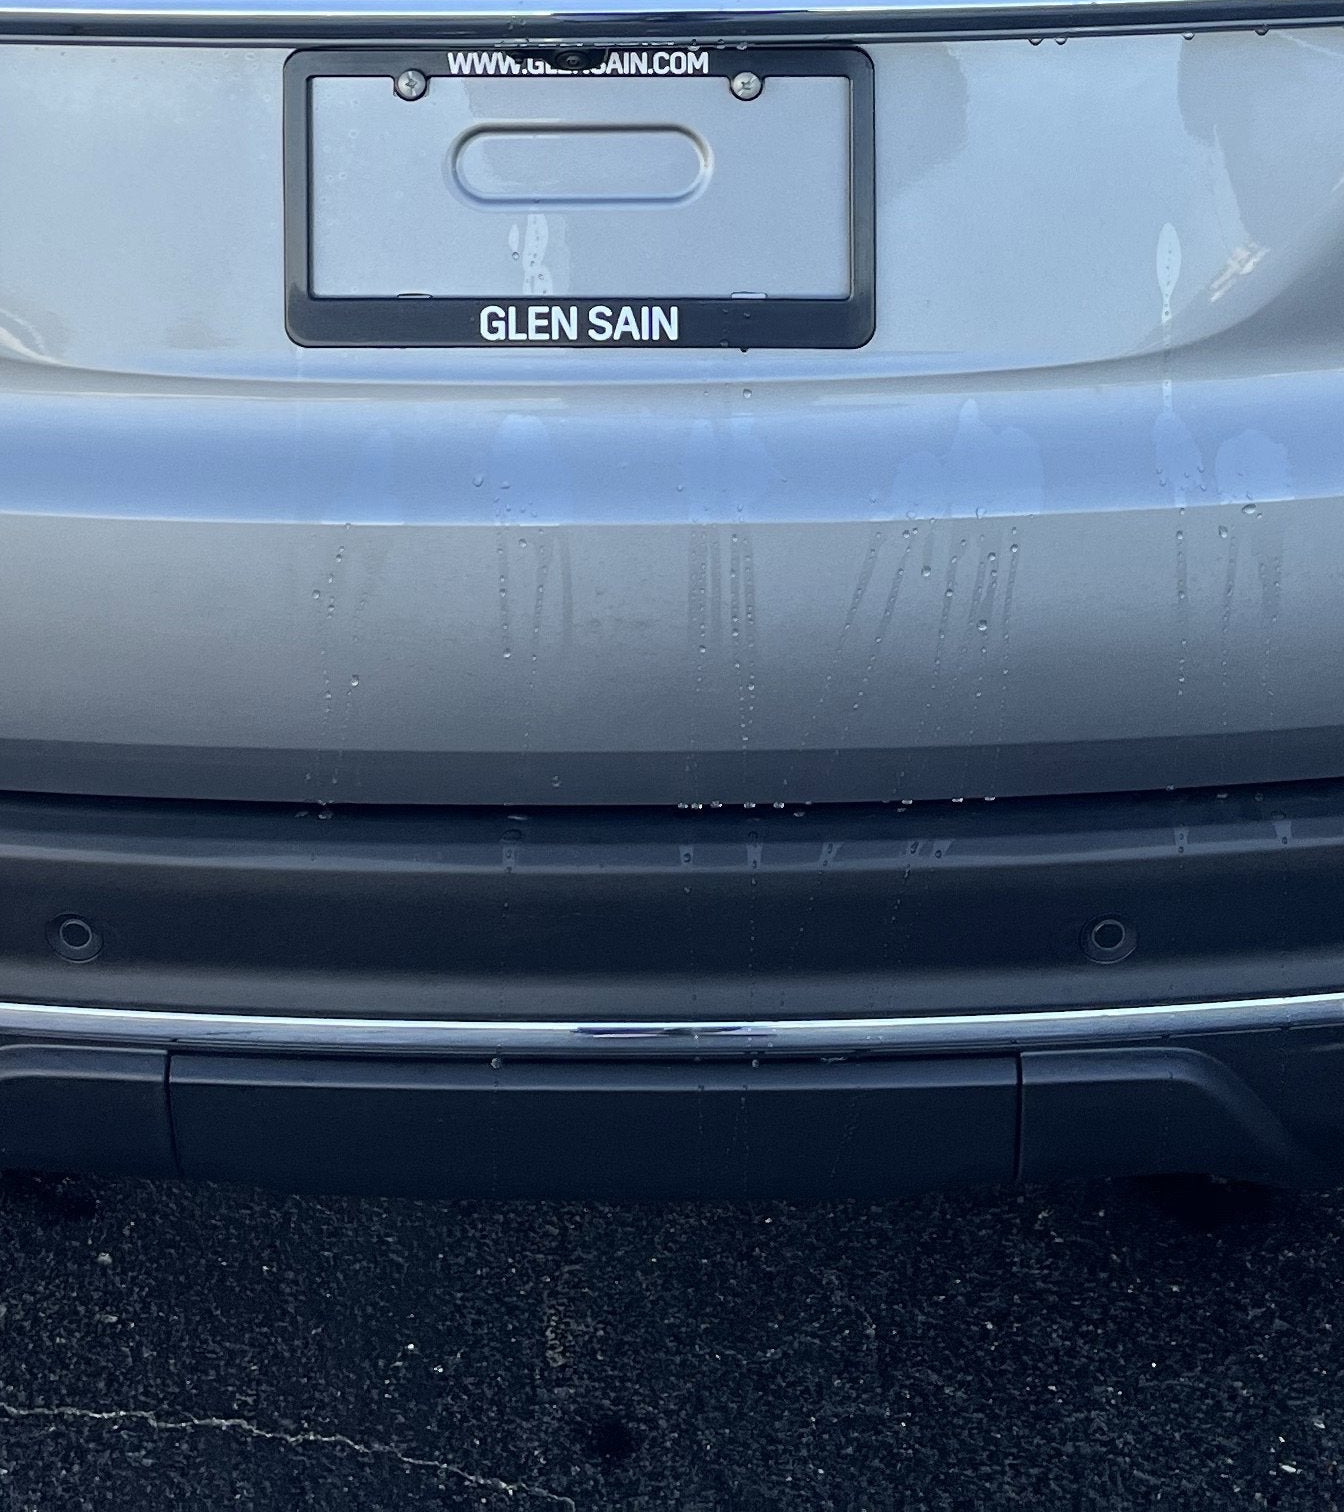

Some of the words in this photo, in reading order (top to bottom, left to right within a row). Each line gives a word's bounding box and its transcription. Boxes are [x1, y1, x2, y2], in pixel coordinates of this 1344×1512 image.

[447, 51, 709, 75] WWW.GLAIN.COM
[479, 305, 578, 341] GLEN
[587, 305, 679, 341] SAIN
